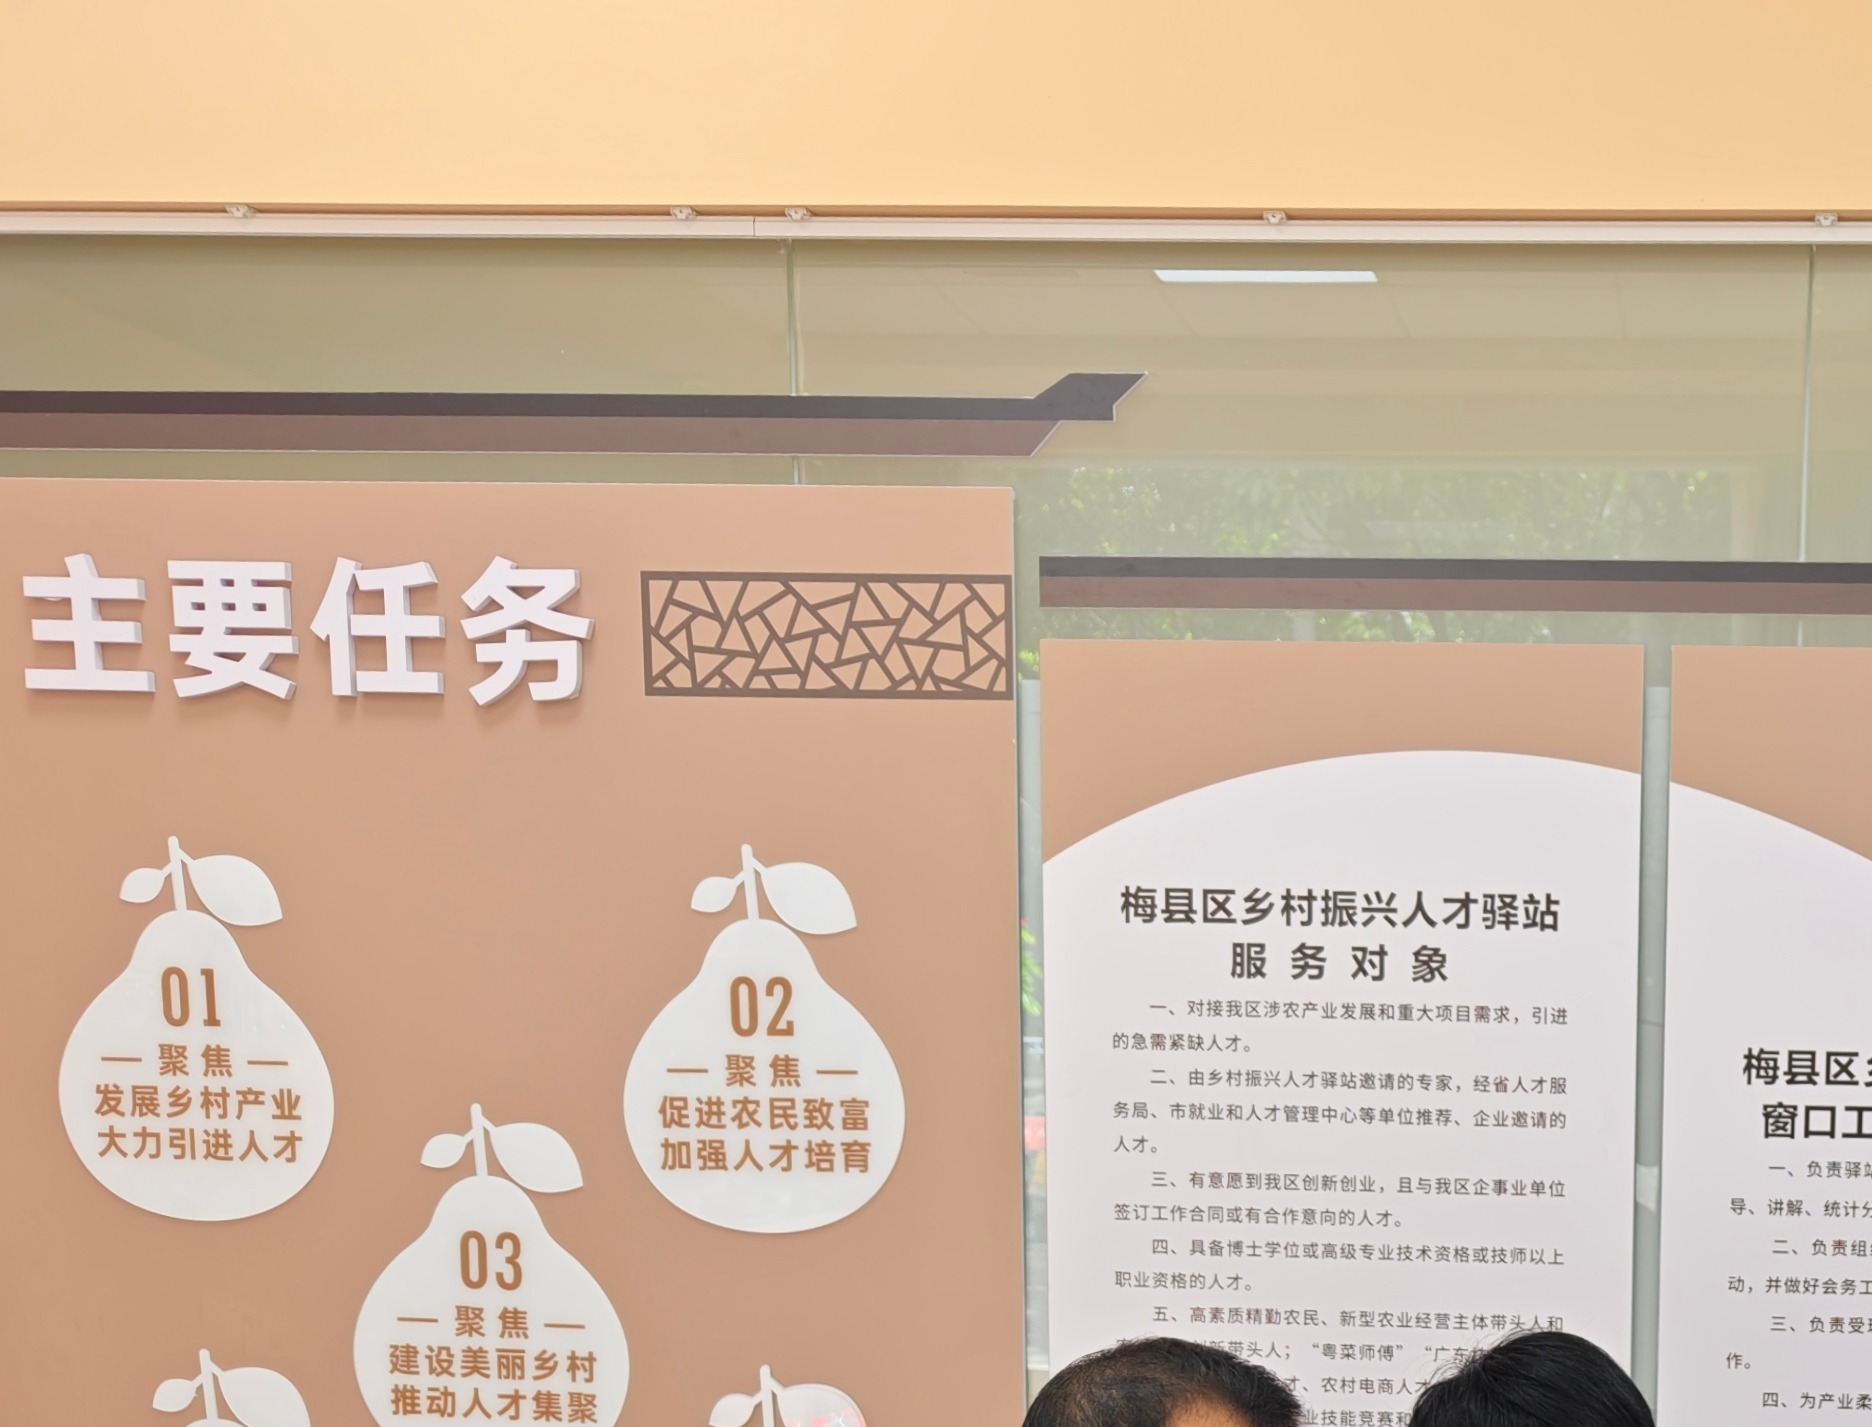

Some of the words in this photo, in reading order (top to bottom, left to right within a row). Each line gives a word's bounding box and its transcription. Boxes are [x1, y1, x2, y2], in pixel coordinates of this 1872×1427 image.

[22, 553, 595, 708] 主要任务
[1121, 885, 1560, 932] 梅县区乡村振兴人才驿站
[1230, 942, 1448, 983] 服务对象
[161, 967, 221, 1027] 01
[730, 976, 794, 1037] 02
[1149, 1000, 1567, 1025] 一、对接我区涉农产业发展和重大项目需求，引进
[1113, 1032, 1250, 1052] 的急需紧缺人才。
[158, 1044, 232, 1077] 聚焦
[725, 1054, 801, 1087] 聚焦
[1150, 1069, 1566, 1094] 二、由乡村振兴人才驿站邀请的专家，经省人才服
[95, 1084, 302, 1120] 发展乡村产业
[658, 1096, 869, 1131] 促进农民致富
[1114, 1102, 1566, 1129] 务局、市就业和人才管理中心等单位推荐、企业邀请的
[98, 1125, 302, 1163] 大力引进人才
[661, 1138, 871, 1173] 加强人才培育
[1114, 1136, 1157, 1153] 人才。
[1152, 1171, 1565, 1197] 三、有意愿到我区创新创业，且与我区企事业单位
[1114, 1204, 1401, 1227] 签订工作合同或有合作意向的人才。
[460, 1231, 522, 1291] 03
[1152, 1239, 1564, 1265] 四、具备博士学位或高级专业技术资格或技师以上
[1115, 1271, 1251, 1291] 职业资格的人才。
[455, 1305, 529, 1339] 聚焦
[389, 1343, 597, 1385] 建设美丽乡村
[1726, 1353, 1750, 1369] 作。
[391, 1384, 597, 1424] 推动人才集聚
